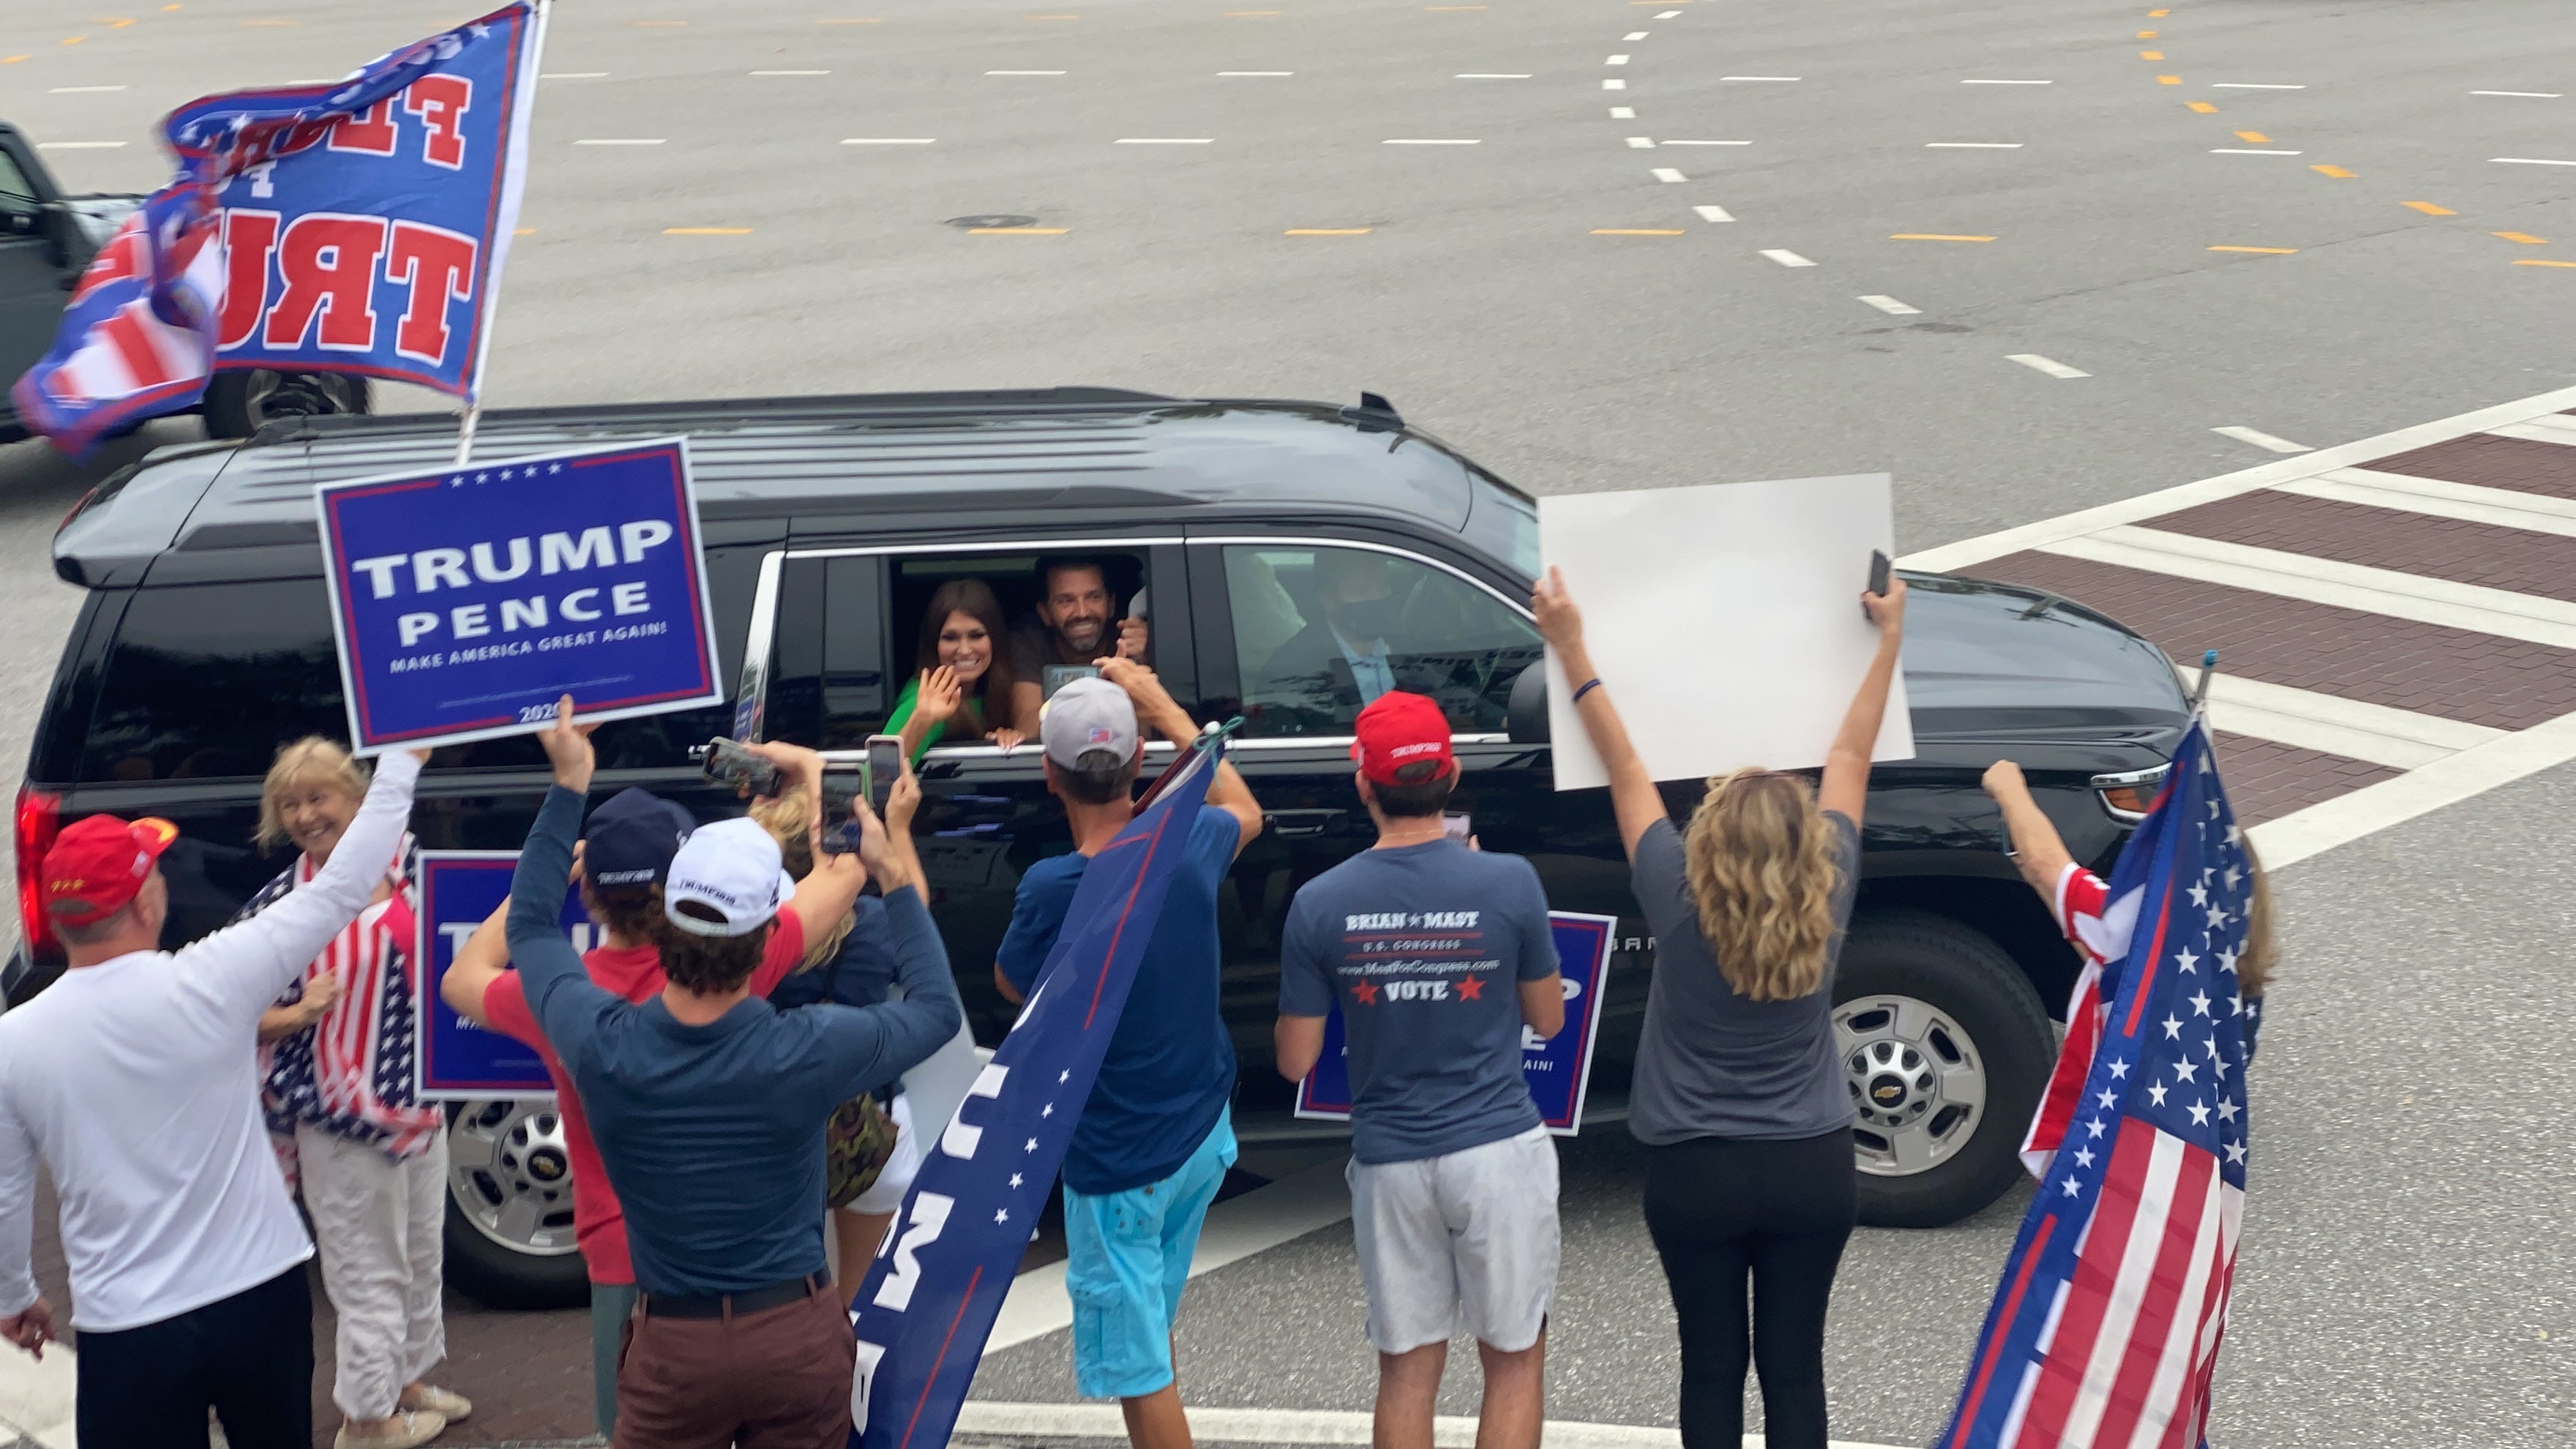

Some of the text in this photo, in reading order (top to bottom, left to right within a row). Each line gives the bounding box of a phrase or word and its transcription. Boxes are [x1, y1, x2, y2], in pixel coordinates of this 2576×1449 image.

[351, 519, 673, 599] TRUMP
[397, 581, 651, 647] PENCE
[390, 621, 667, 674] MAKE AMERICA GREAT AGAIN!
[1345, 911, 1480, 931] BRIAN MAST
[1392, 939, 1462, 951] CONGRESS
[1384, 980, 1450, 1002] VOTE
[1523, 1058, 1554, 1072] AIN!
[850, 1063, 1010, 1437] UMP
